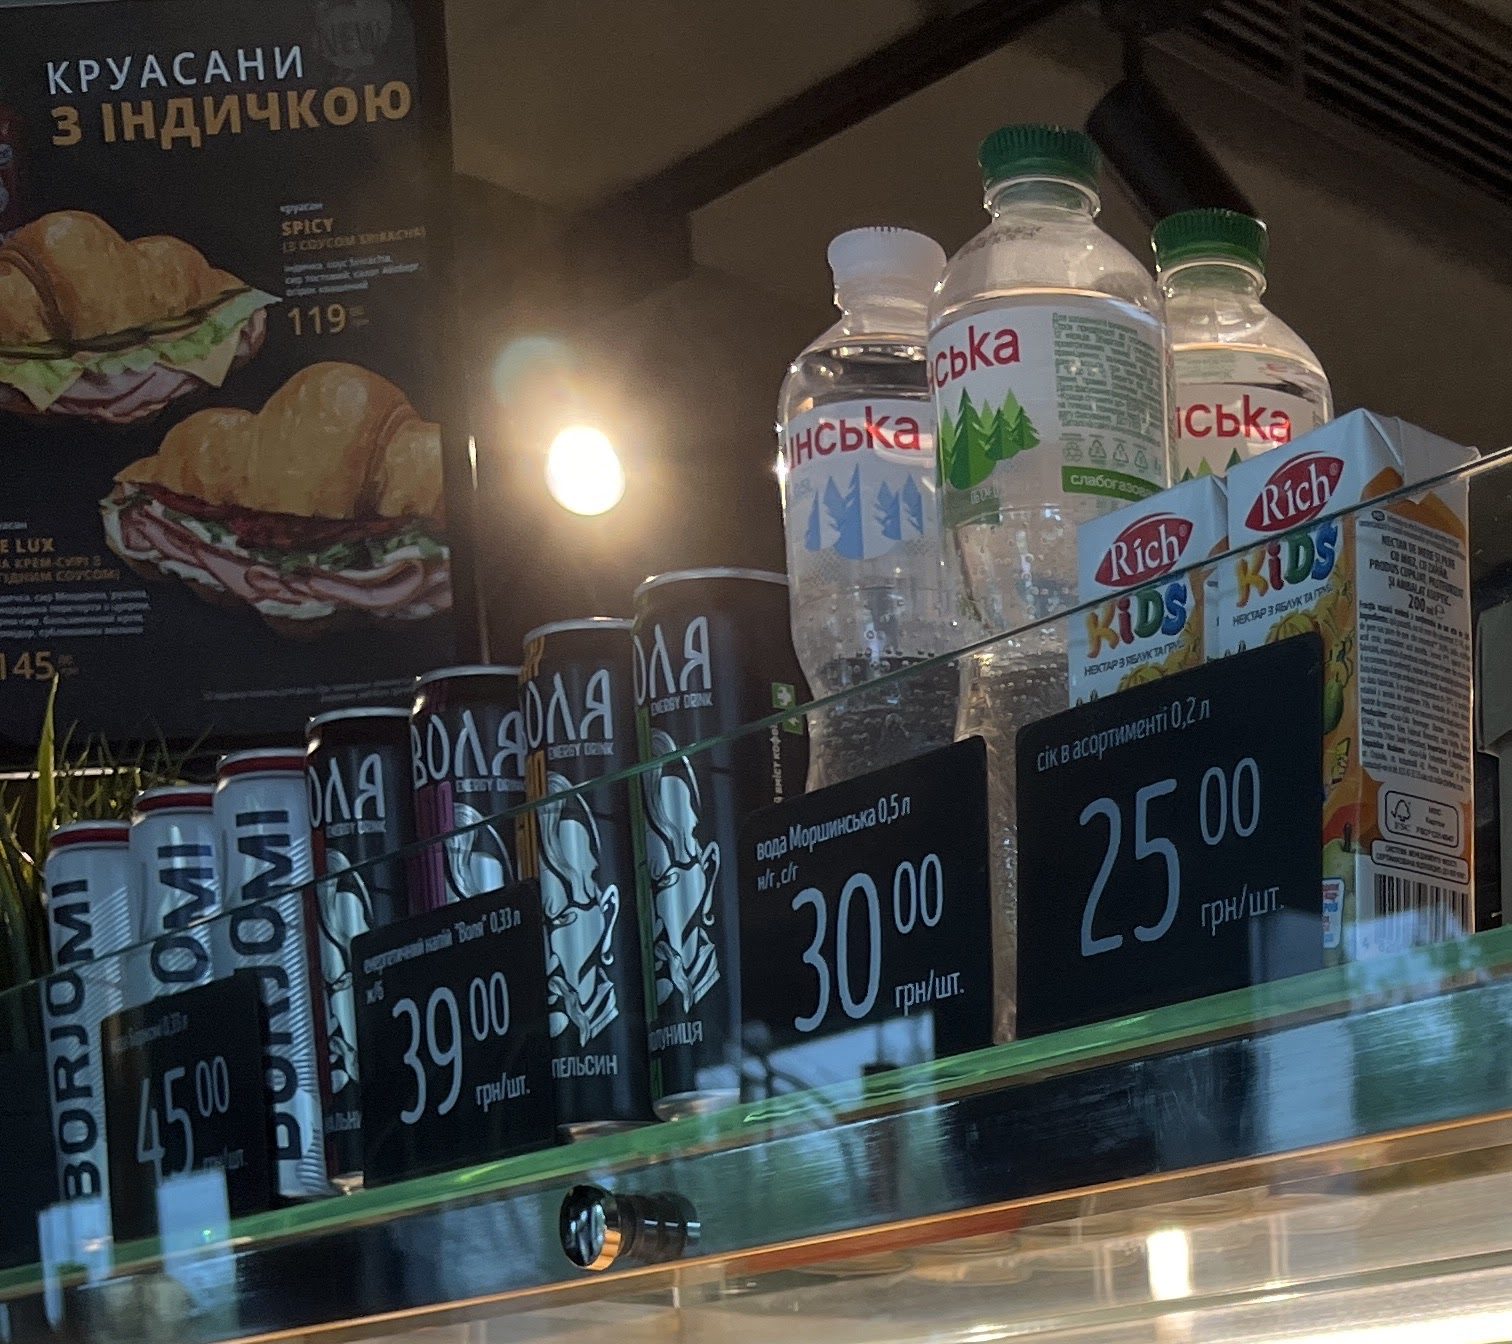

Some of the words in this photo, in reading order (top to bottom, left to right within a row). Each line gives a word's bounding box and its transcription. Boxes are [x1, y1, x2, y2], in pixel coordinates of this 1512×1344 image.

[46, 45, 303, 95] КРУАСАНИ
[50, 105, 83, 147] З
[102, 80, 412, 150] ІНДИЧКОЮ
[281, 217, 334, 237] SPICY
[287, 302, 347, 336] 119
[15, 537, 56, 554] LUX
[1233, 611, 1266, 627] НЕКТАР
[1409, 593, 1425, 612] 200
[1084, 661, 1118, 677] НЕКТАР
[410, 708, 526, 790] ВОЛЯ
[1037, 744, 1058, 774] сік
[1060, 745, 1071, 764] в
[1072, 705, 1168, 760] асортименті
[1170, 696, 1196, 730] 0,2
[1198, 697, 1211, 721] л
[756, 835, 788, 862] вода
[788, 806, 877, 853] Моршинська
[877, 792, 900, 825] 0,5
[901, 795, 911, 816] л
[1078, 777, 1181, 957] 25
[1198, 757, 1261, 847] 00
[1200, 883, 1286, 937] грн/шт.
[791, 871, 882, 1033] 30
[892, 852, 944, 934] 00
[894, 968, 965, 1018] грн/шт.
[45, 878, 100, 1199] BORJOMI
[392, 986, 463, 1125] 39
[469, 971, 511, 1042] 00
[195, 1055, 231, 1118] 00
[475, 1071, 532, 1113] грн/шт.
[551, 1054, 618, 1079] ПЕЛЬСИН
